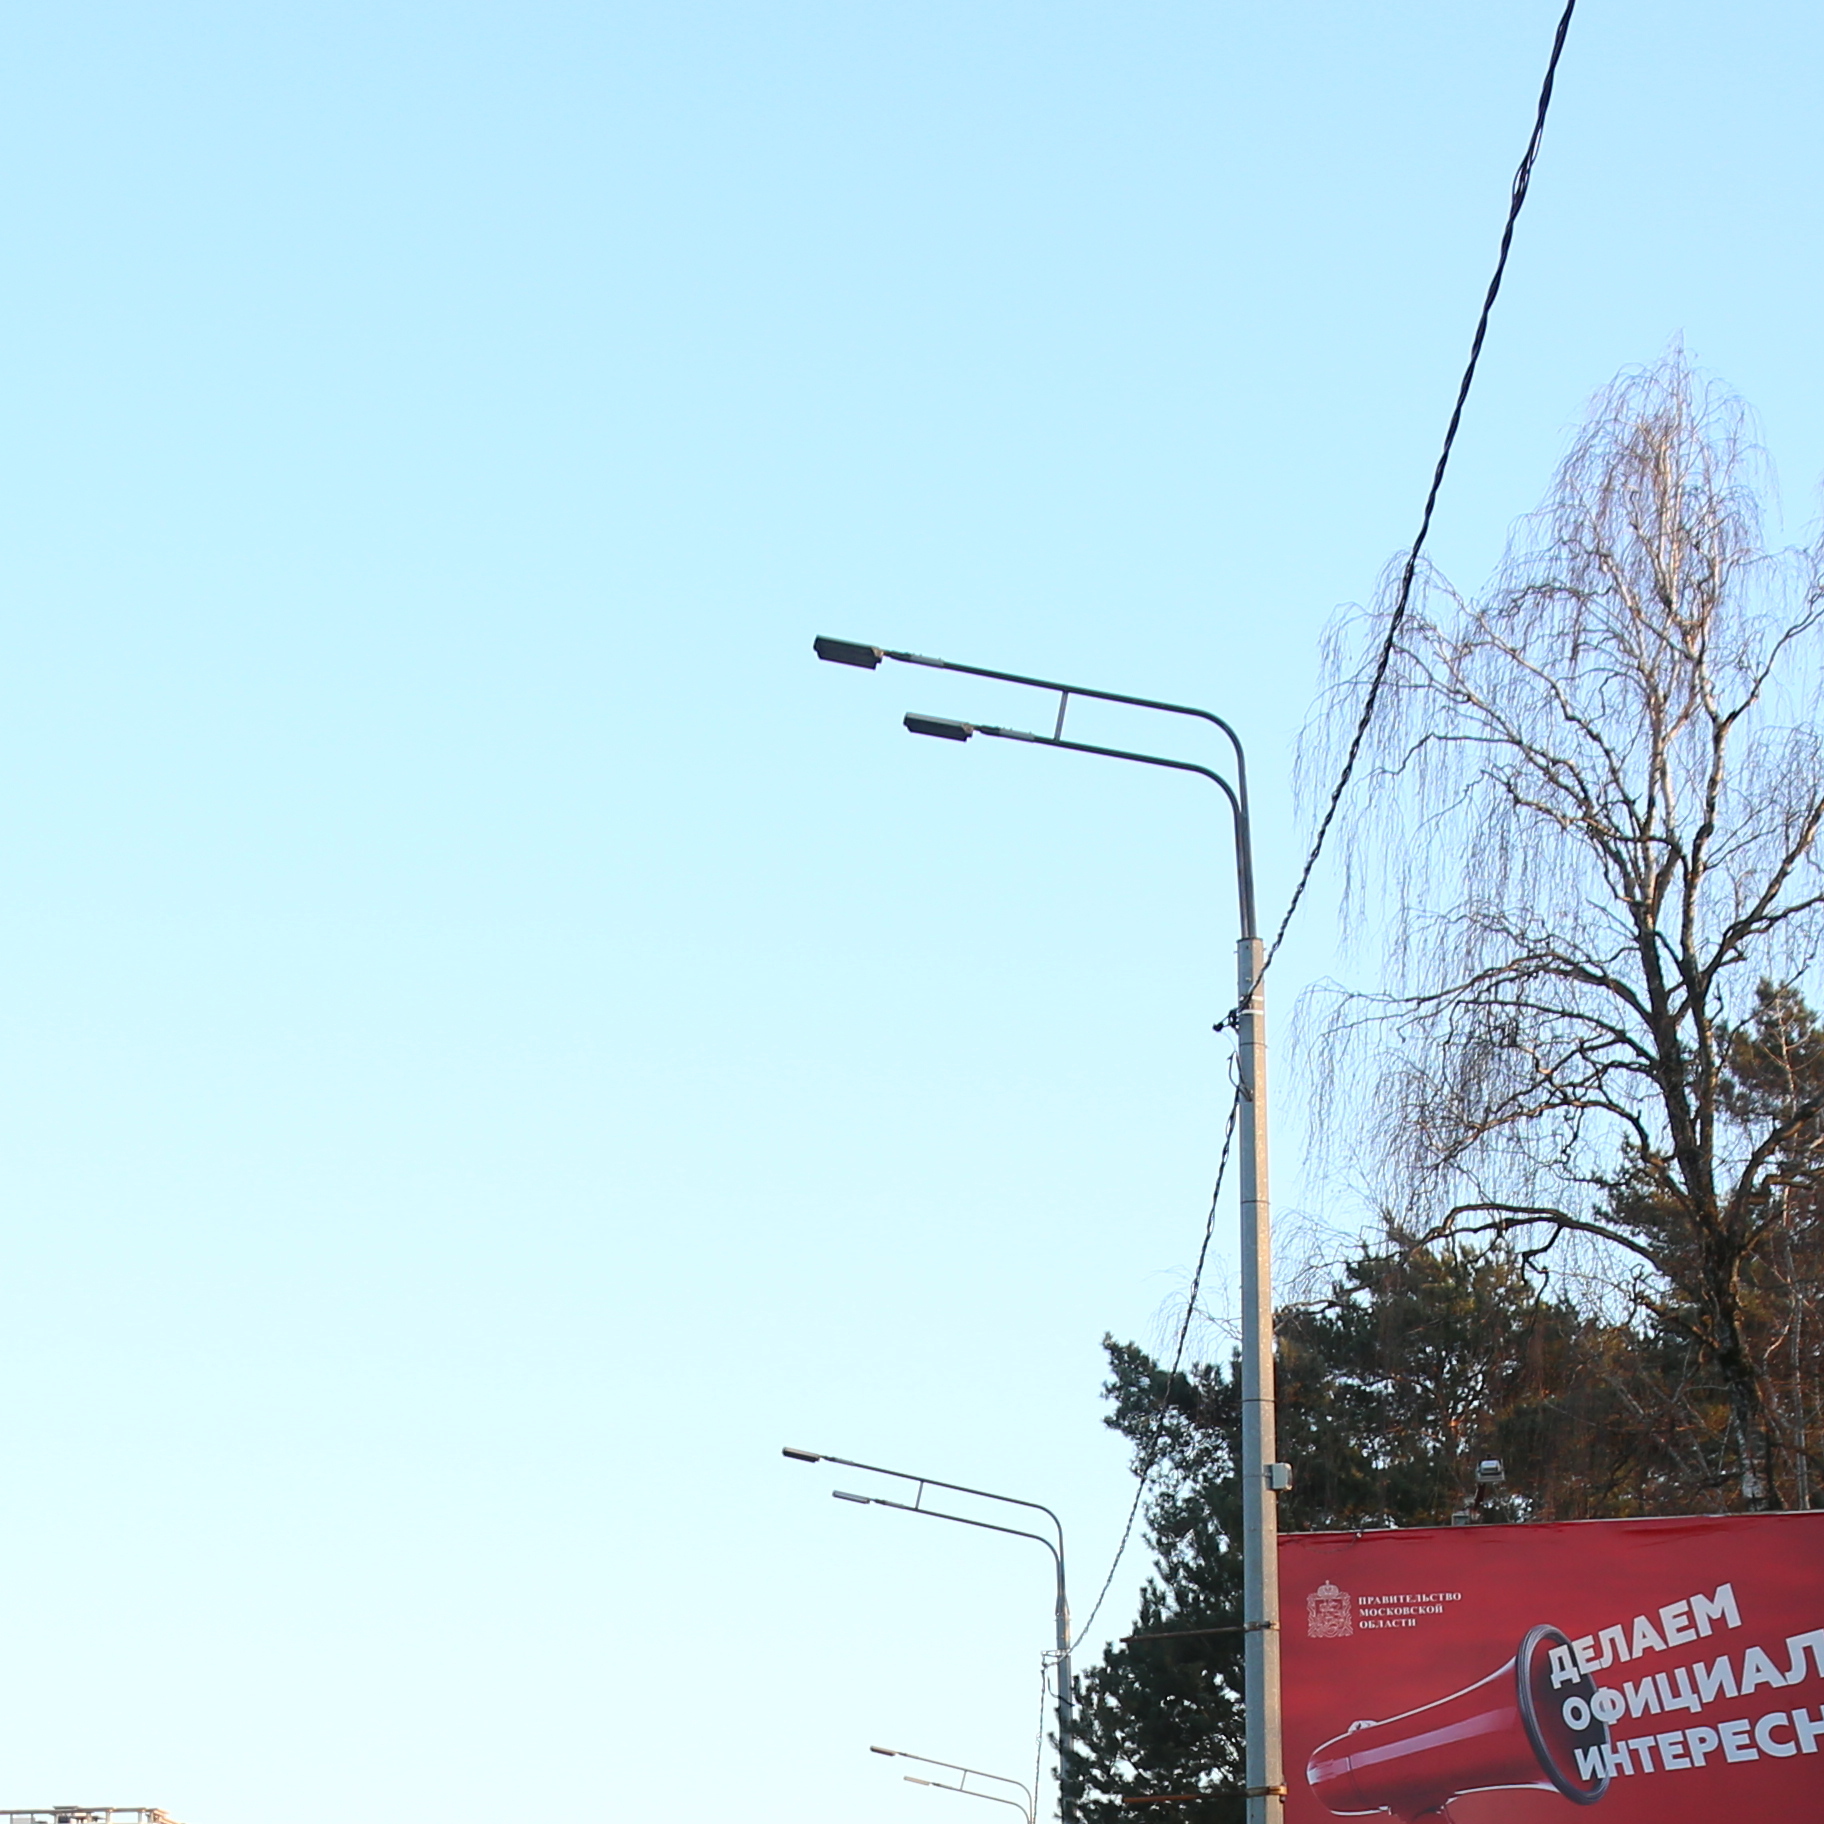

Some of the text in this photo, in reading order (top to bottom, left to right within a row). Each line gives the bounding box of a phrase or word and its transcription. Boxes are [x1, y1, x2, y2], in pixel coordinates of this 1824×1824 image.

[1358, 1592, 1462, 1605] ПРАВИТЕЛЬСТВО
[1359, 1604, 1444, 1617] МОСКОВСКОЙ
[1359, 1618, 1416, 1629] ОБЛАСТИ
[1548, 1582, 1742, 1689] ДЕЛАЕМ
